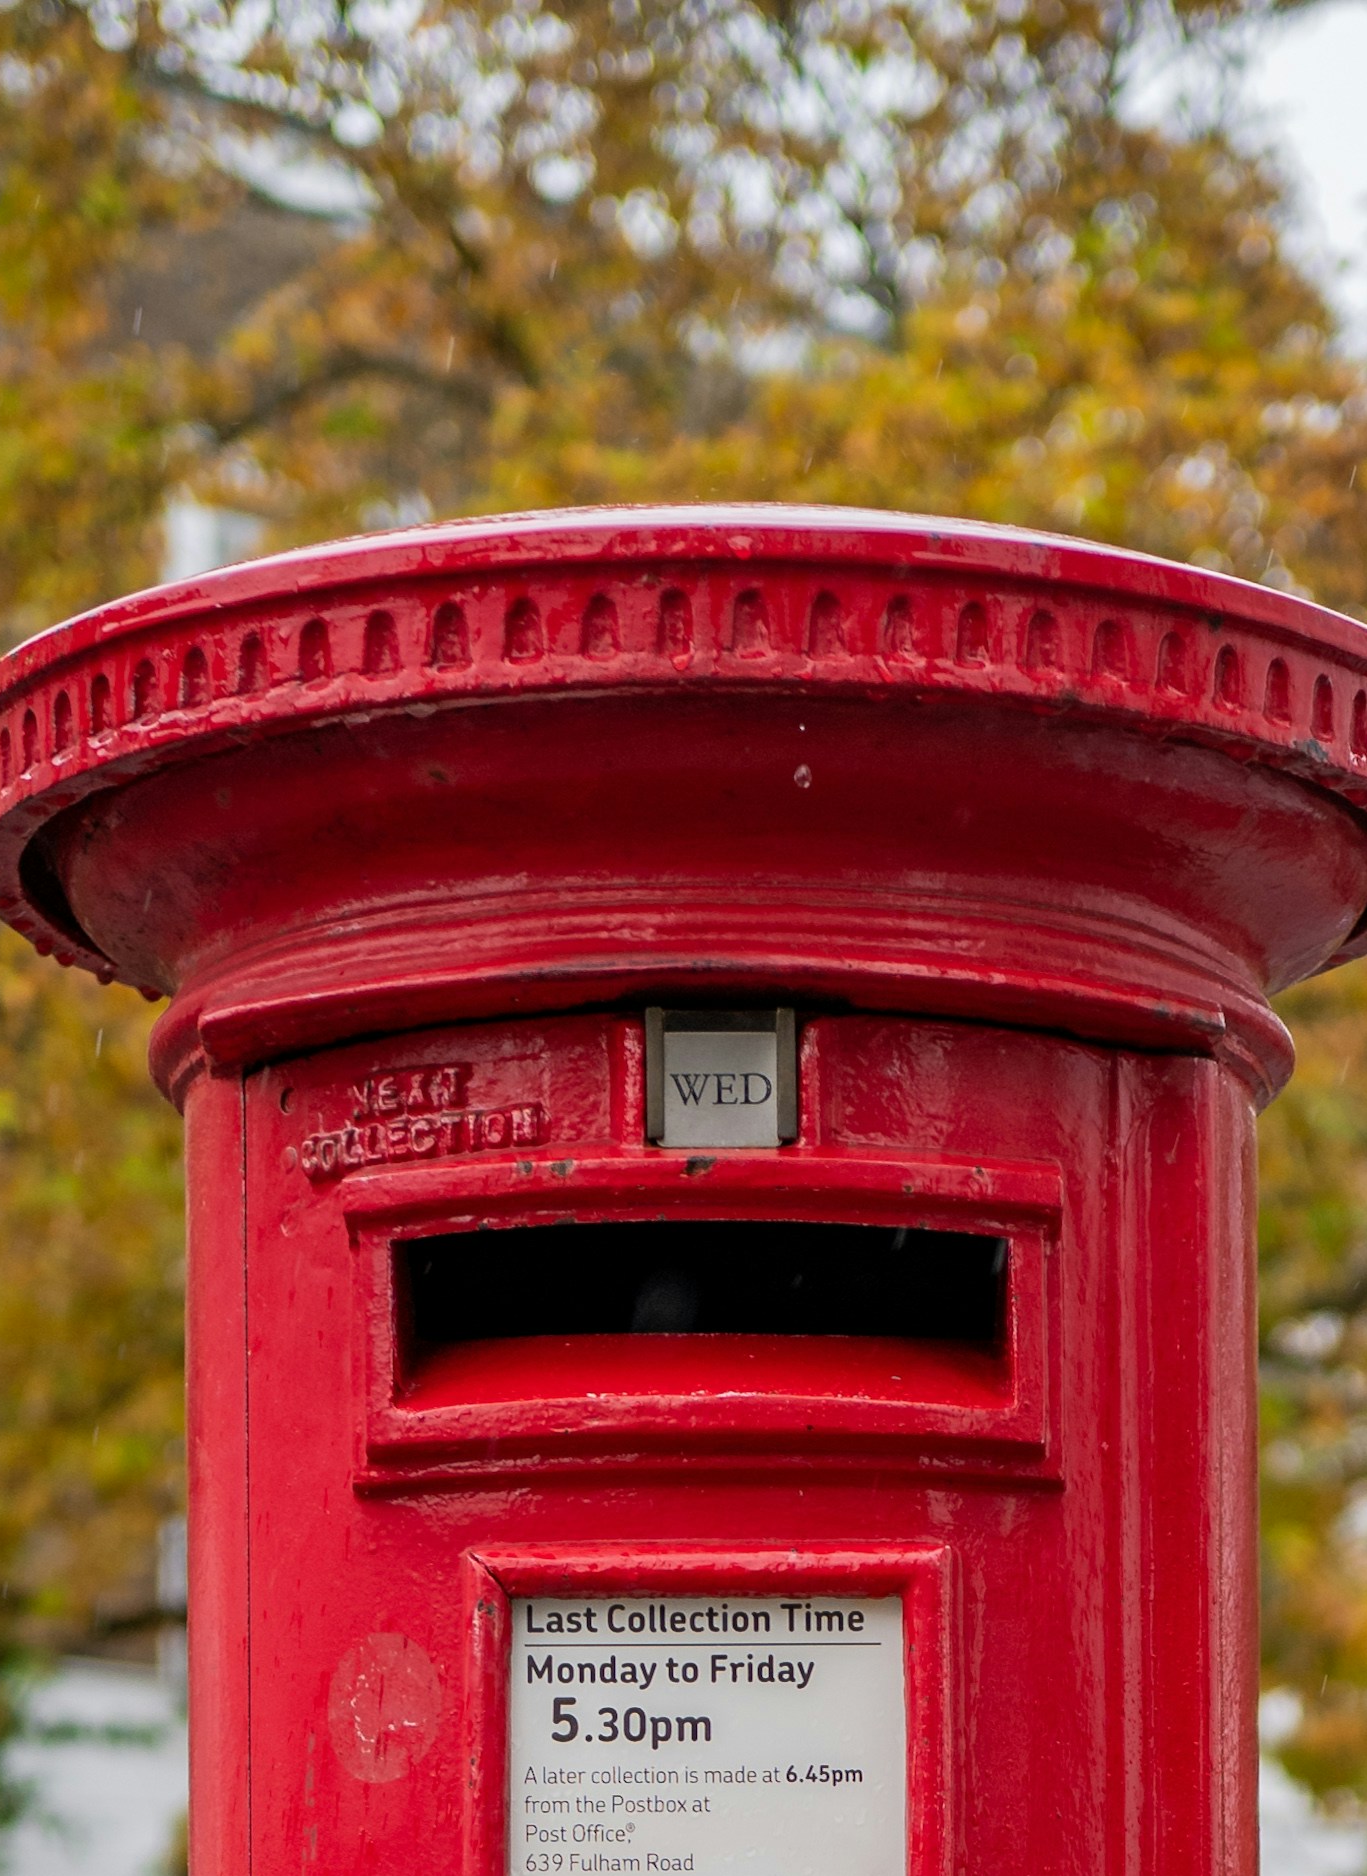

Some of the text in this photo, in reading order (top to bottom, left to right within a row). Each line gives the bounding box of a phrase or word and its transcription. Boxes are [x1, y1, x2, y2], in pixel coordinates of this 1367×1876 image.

[669, 1071, 773, 1107] WED
[301, 1107, 546, 1173] COLLECTION
[526, 1603, 865, 1634] Last Collection Time
[527, 1655, 814, 1689] Monday to Friday
[551, 1697, 712, 1750] 5.30pm
[524, 1765, 864, 1788] A later collection is made at 6.45pm
[524, 1796, 711, 1814] from the Postbox at
[526, 1825, 567, 1843] Post
[525, 1854, 695, 1873] 639 Fulham Road
